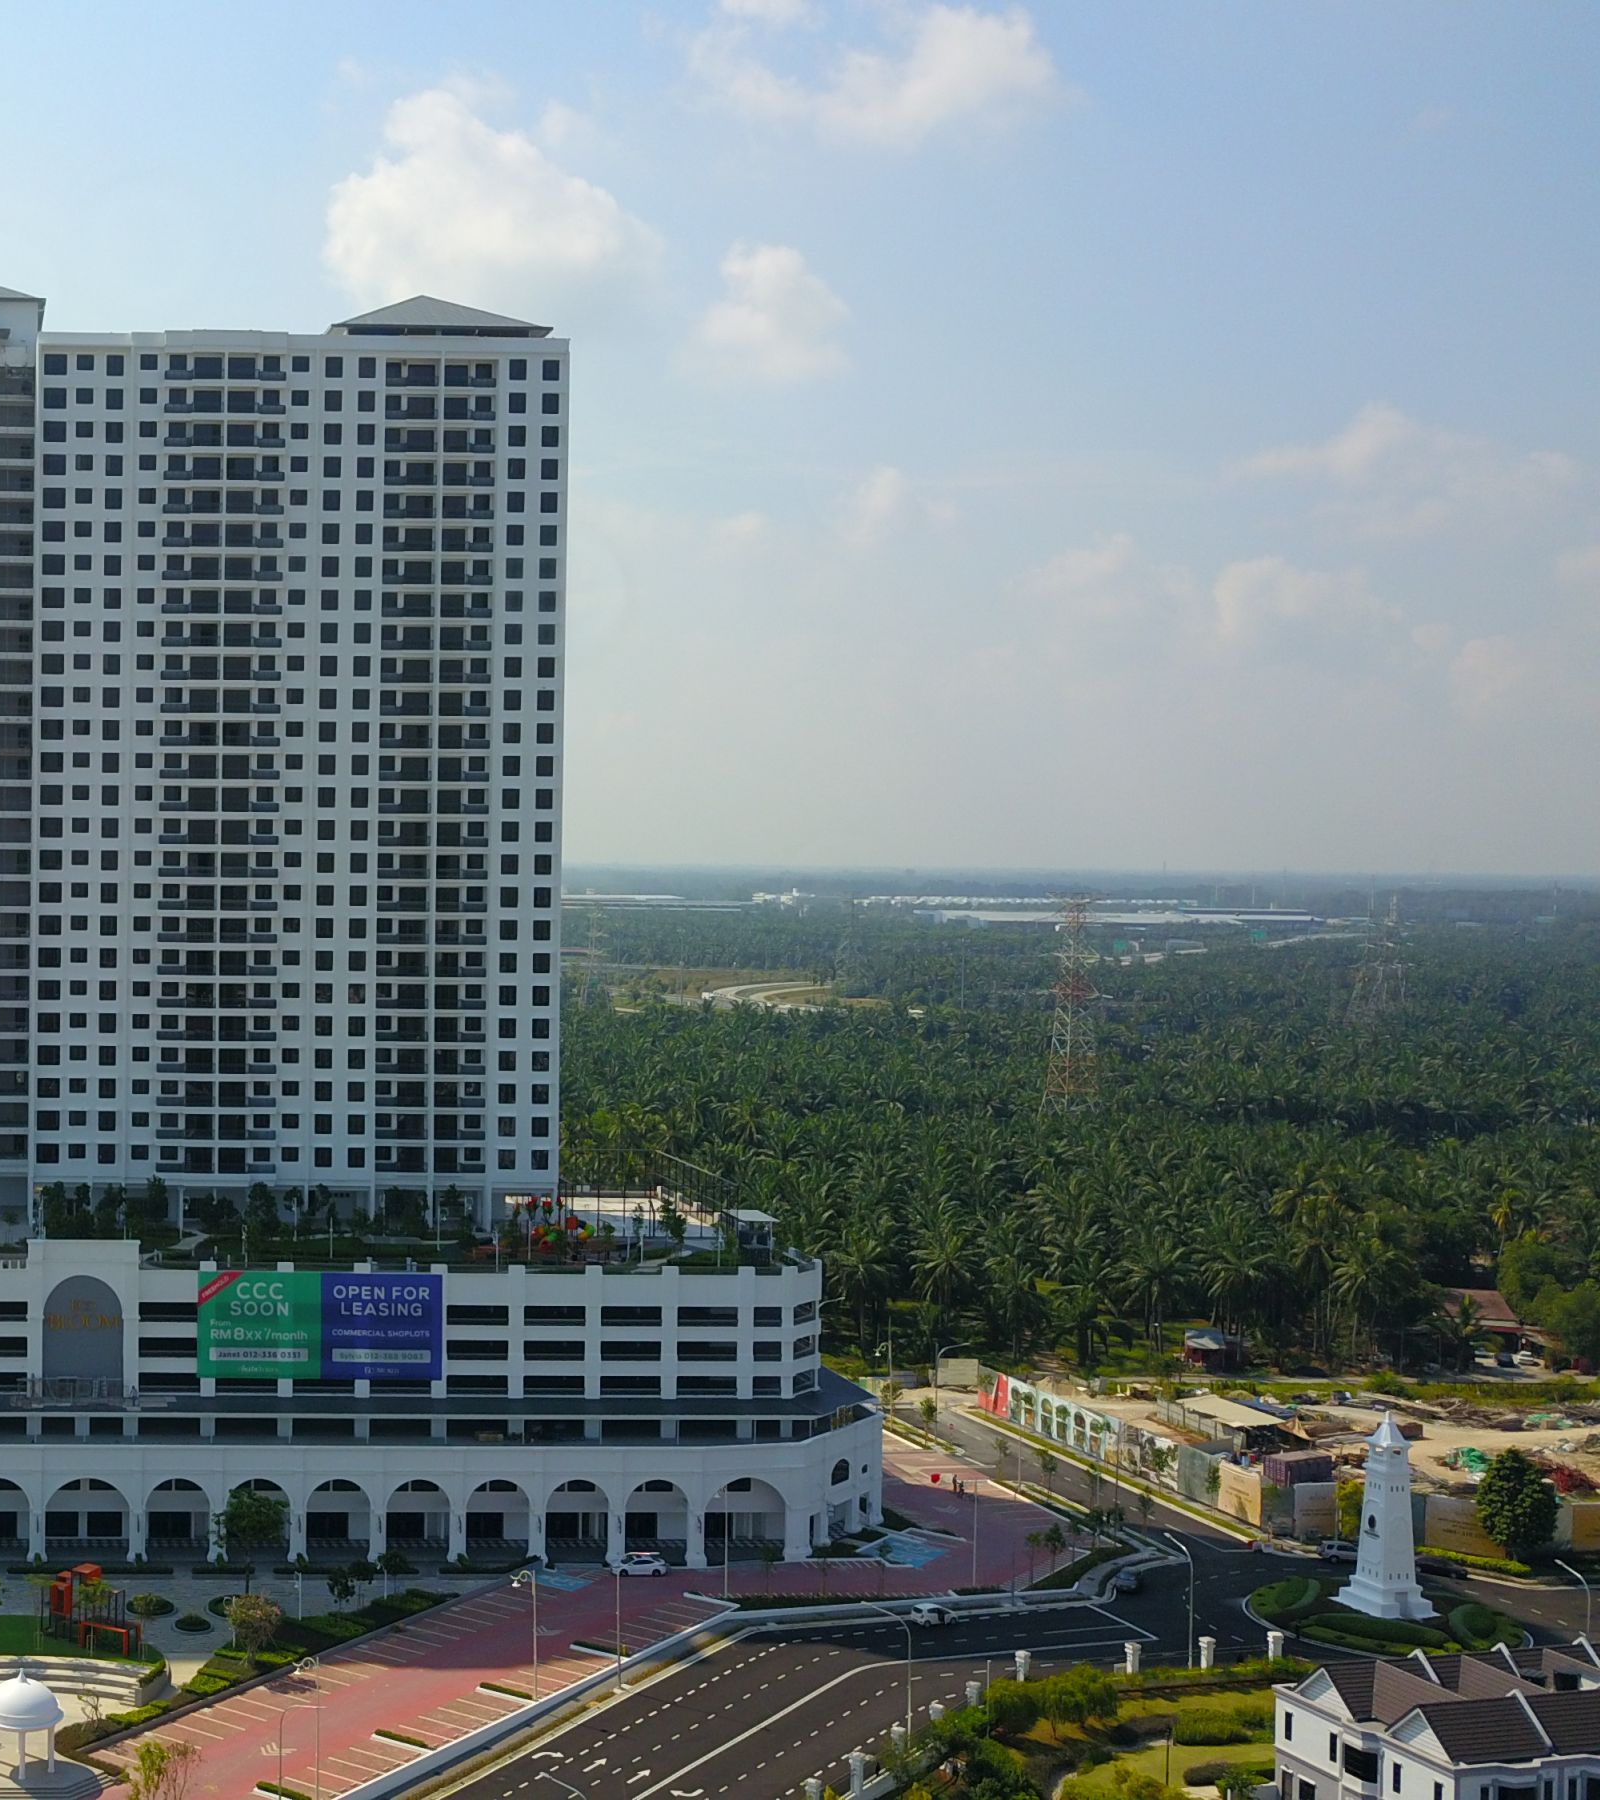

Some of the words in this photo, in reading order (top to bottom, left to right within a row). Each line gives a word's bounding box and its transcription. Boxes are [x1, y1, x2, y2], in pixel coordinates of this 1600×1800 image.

[236, 1282, 284, 1299] CCC
[333, 1285, 385, 1300] OPEN
[392, 1286, 430, 1300] FOR
[229, 1301, 289, 1316] SOON
[340, 1301, 423, 1316] LEASING
[210, 1319, 231, 1327] From
[332, 1329, 385, 1337] COMMERCIAL
[387, 1330, 430, 1338] SHOPLOTS
